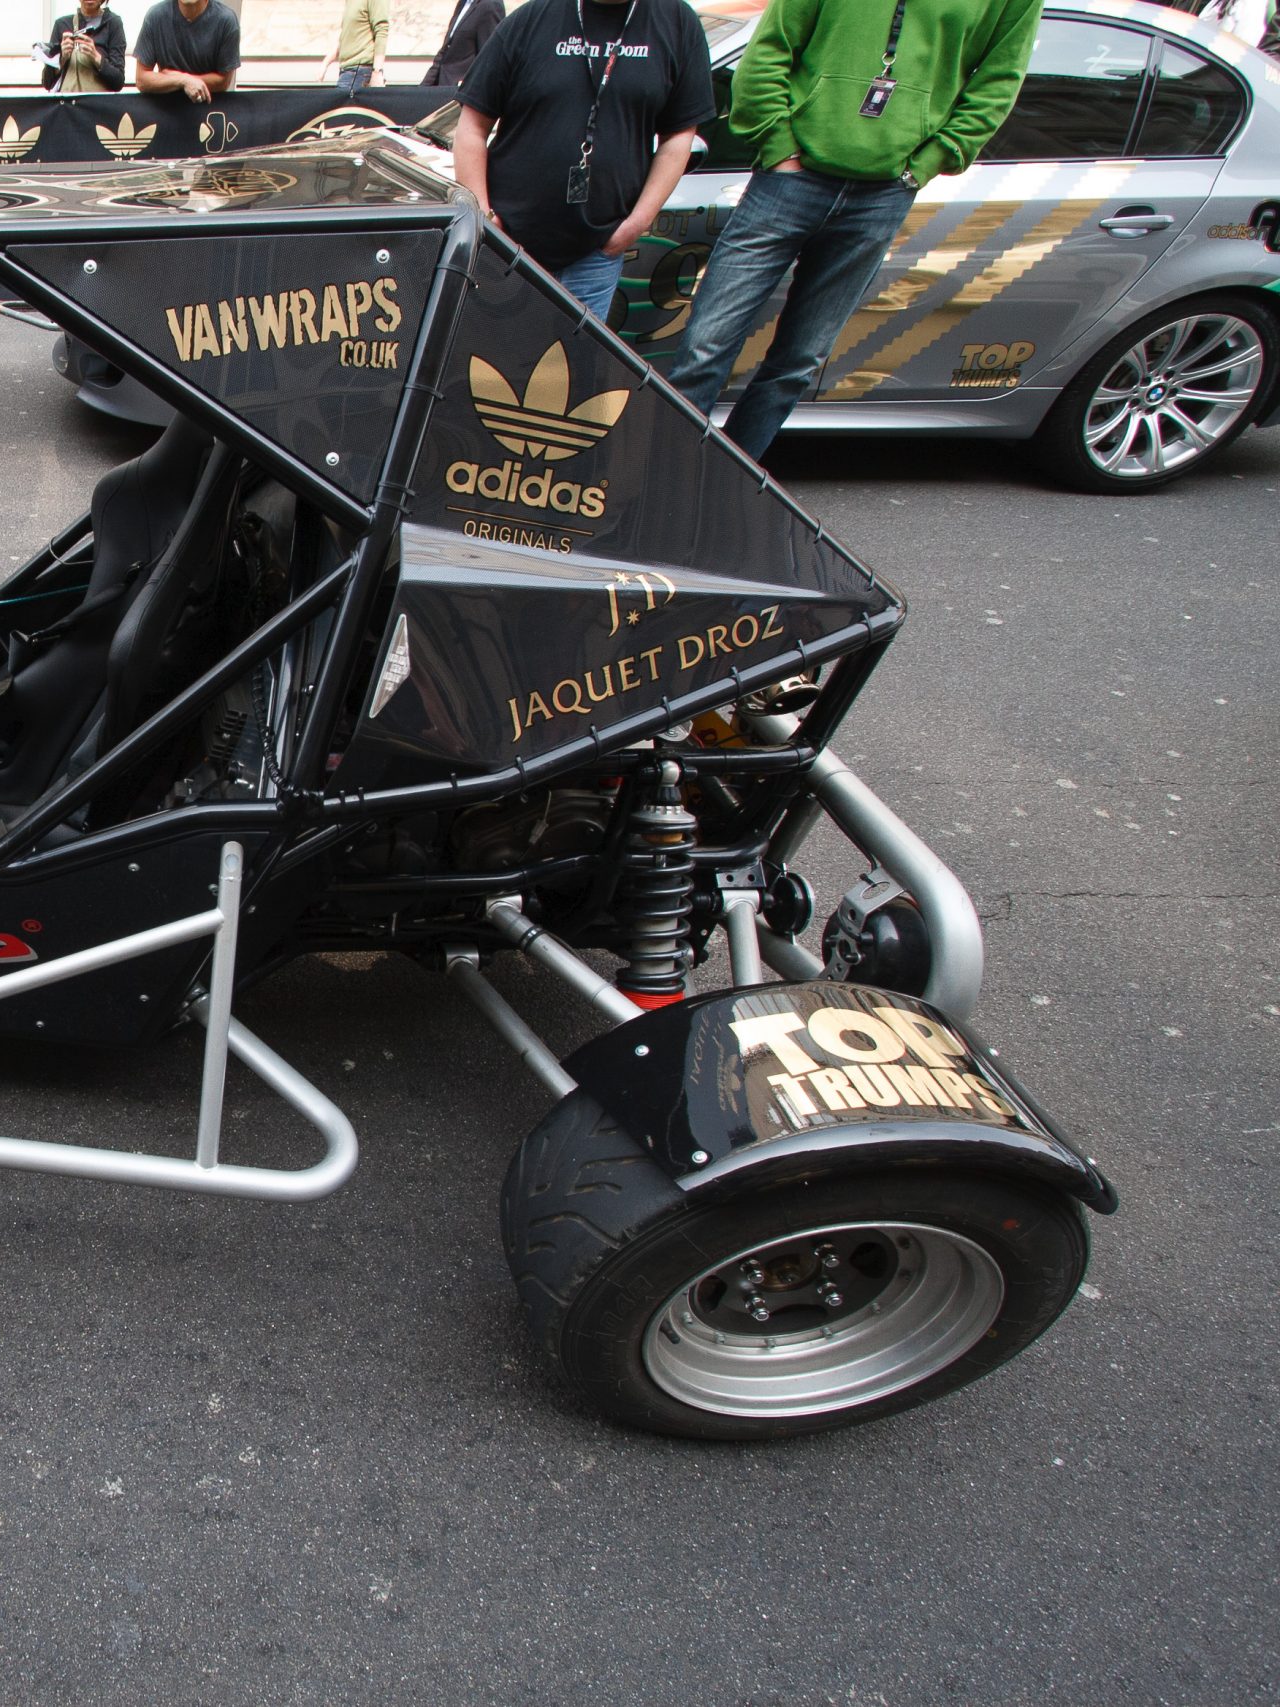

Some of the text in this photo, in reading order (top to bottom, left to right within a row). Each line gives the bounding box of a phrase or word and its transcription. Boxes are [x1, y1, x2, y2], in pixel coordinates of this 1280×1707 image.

[569, 36, 582, 45] the
[165, 276, 402, 362] VANWRAPS
[339, 339, 400, 370] CO.UK
[959, 341, 1036, 371] TOP
[949, 369, 1021, 388] TRUMPS
[445, 459, 606, 519] adidas
[463, 519, 573, 555] ORIGINALS
[507, 603, 785, 743] JAQUET DROZ
[727, 1006, 967, 1077] TOP
[766, 1064, 1017, 1117] TRUMPS
